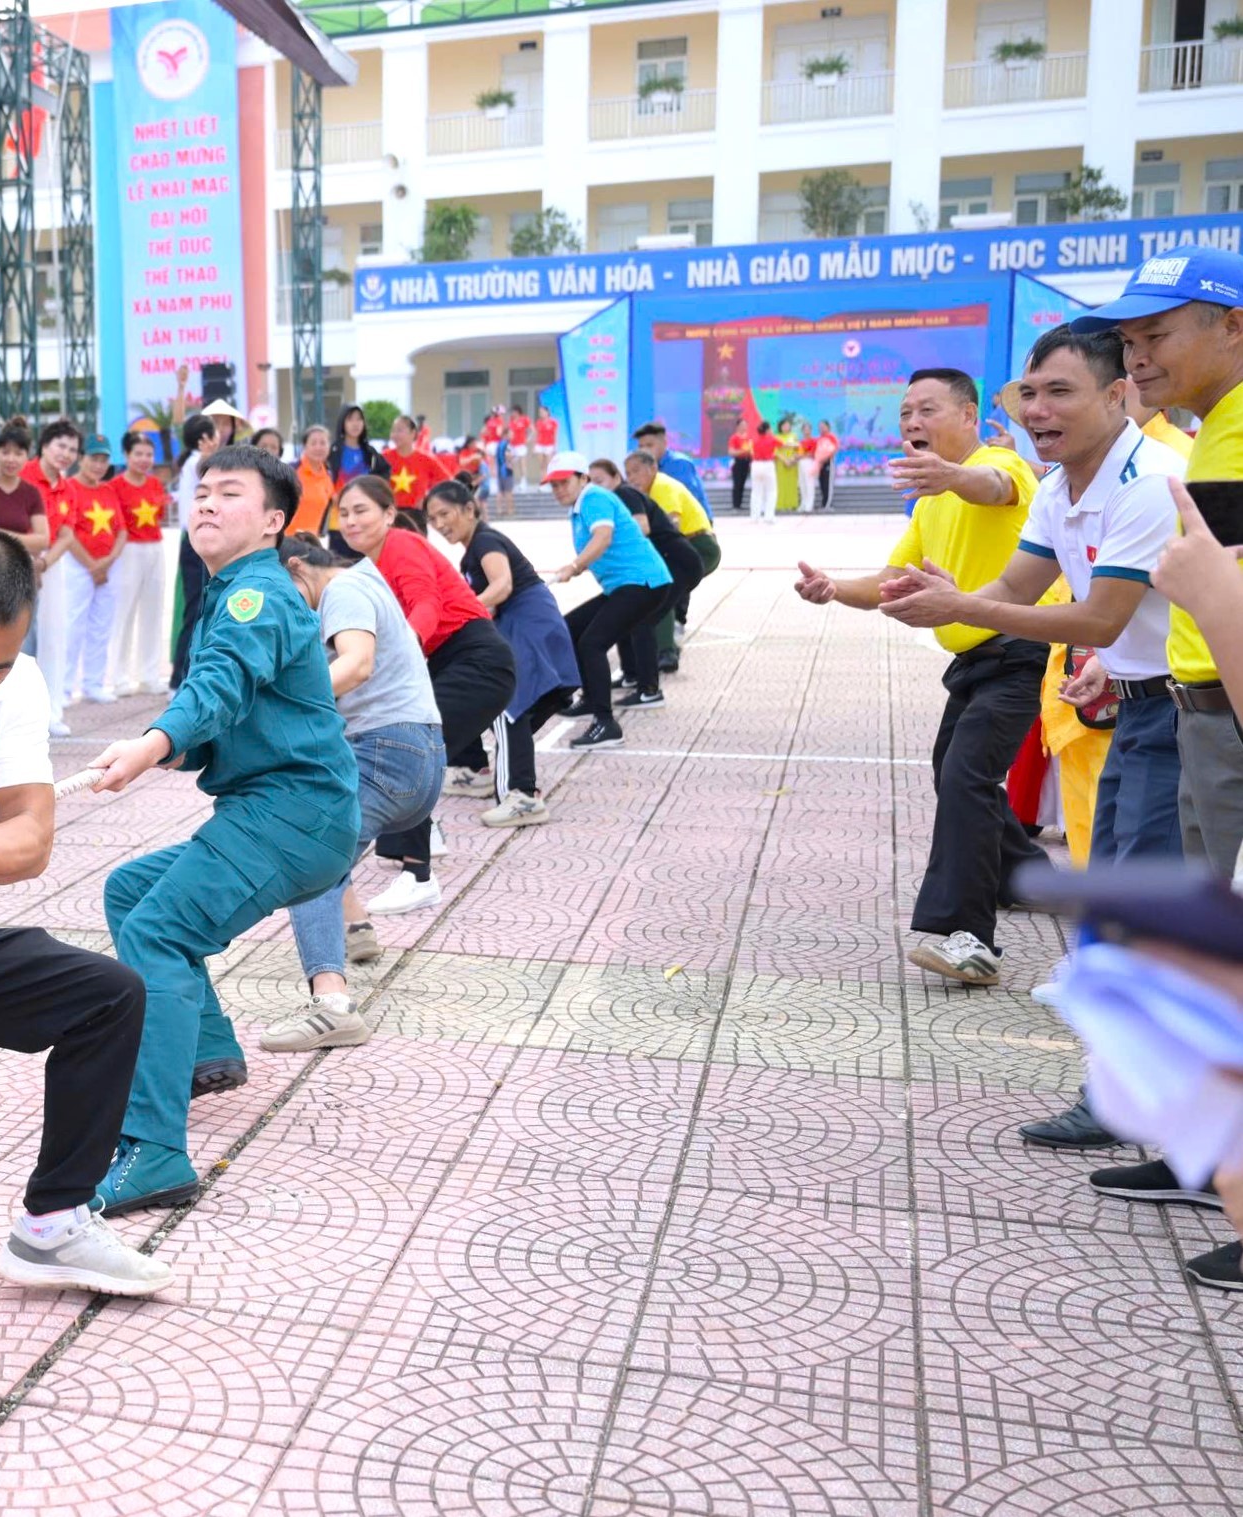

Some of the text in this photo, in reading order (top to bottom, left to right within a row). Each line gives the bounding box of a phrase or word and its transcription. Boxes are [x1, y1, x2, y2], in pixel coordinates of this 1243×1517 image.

[390, 268, 440, 305] NHÀ
[444, 264, 540, 302] TRƯỜNG
[548, 261, 597, 296] VĂN
[605, 256, 655, 293] HÓA
[687, 253, 741, 289] NHÀ
[749, 250, 809, 286] GIÁO
[819, 240, 881, 281] MẪU
[890, 242, 955, 281] MỰC
[1057, 234, 1128, 267] SINH
[157, 296, 193, 313] NAM
